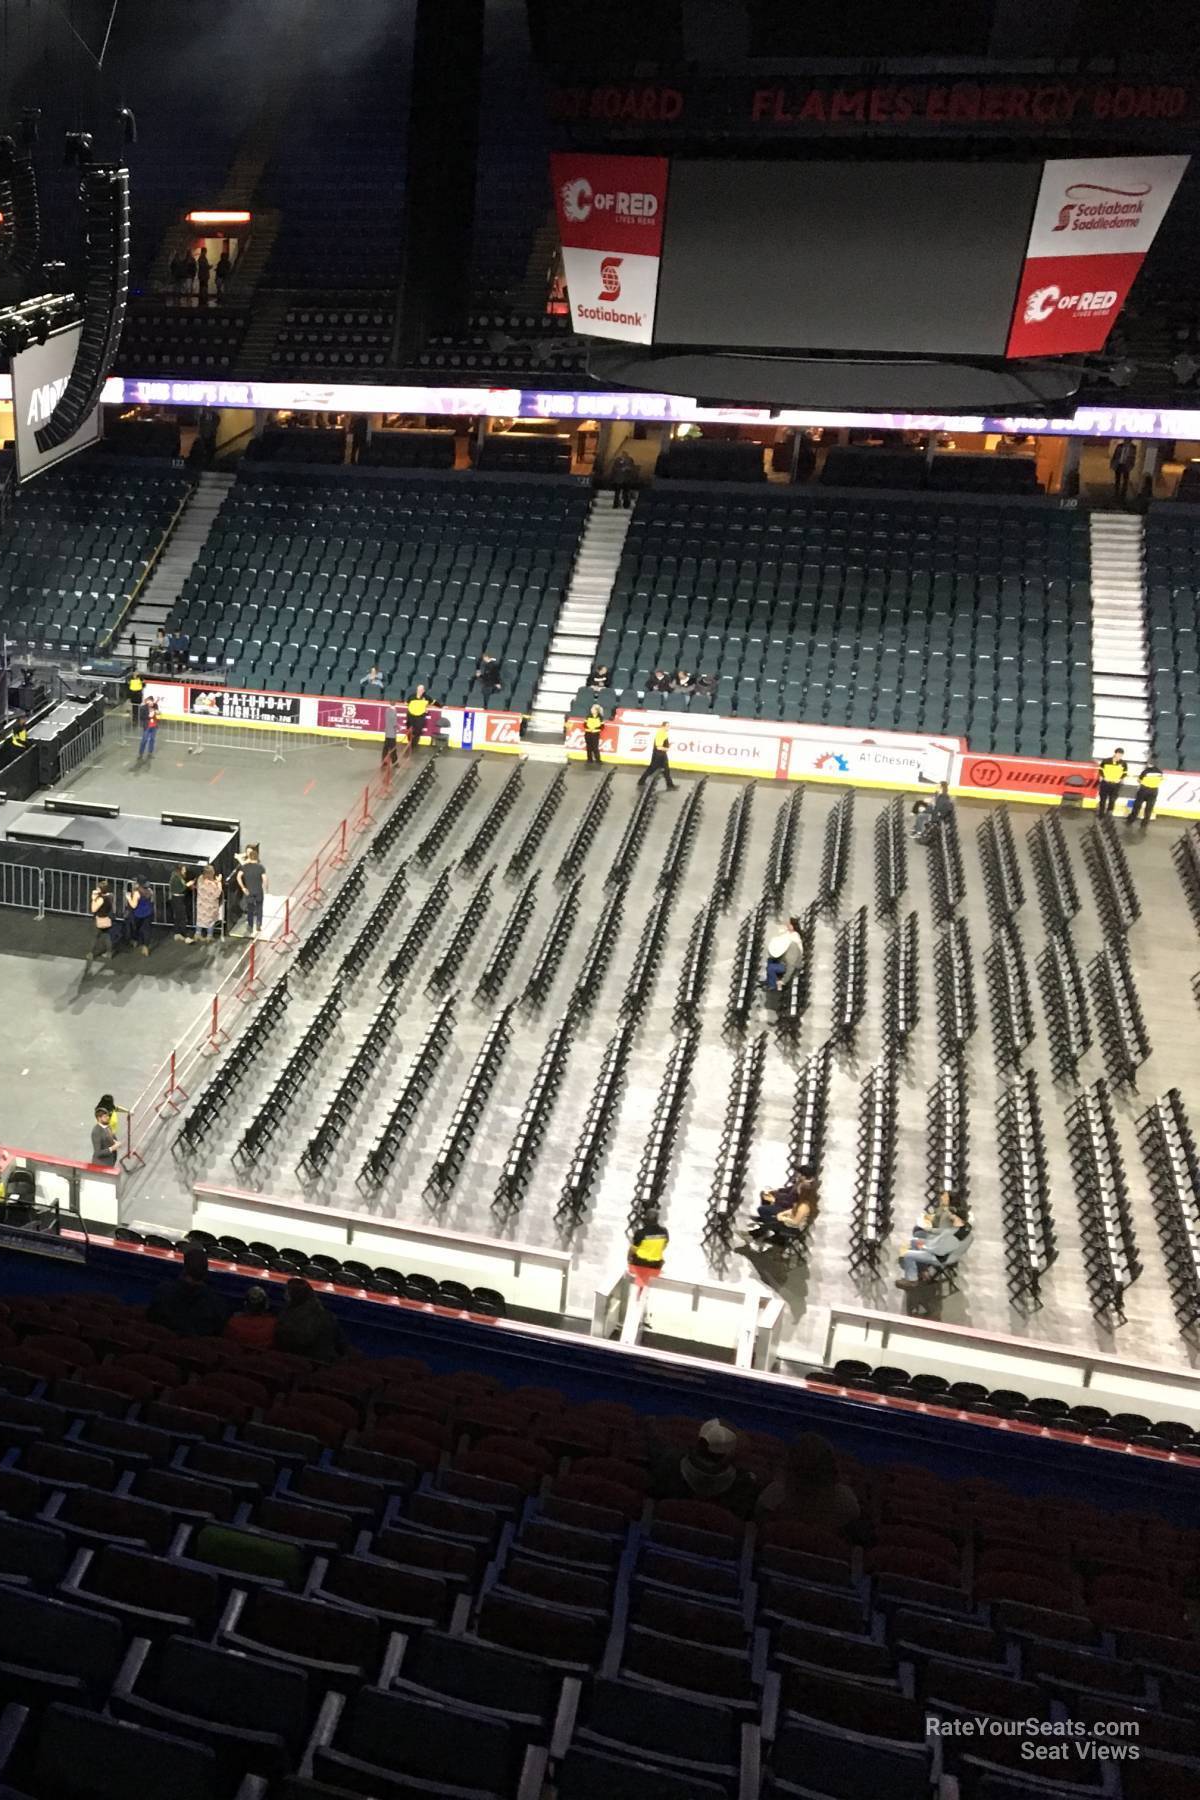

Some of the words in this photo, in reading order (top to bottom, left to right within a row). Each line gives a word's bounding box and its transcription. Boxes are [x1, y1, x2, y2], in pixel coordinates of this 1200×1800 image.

[751, 88, 913, 122] FLAMES
[594, 193, 615, 211] OF
[615, 191, 658, 217] RED
[1076, 200, 1145, 217] Scotiabank
[1058, 295, 1079, 310] OF
[1076, 291, 1118, 311] RED
[577, 304, 642, 327] Scotiabank
[223, 692, 293, 711] SATURDAY
[223, 704, 260, 720] NIGHT!
